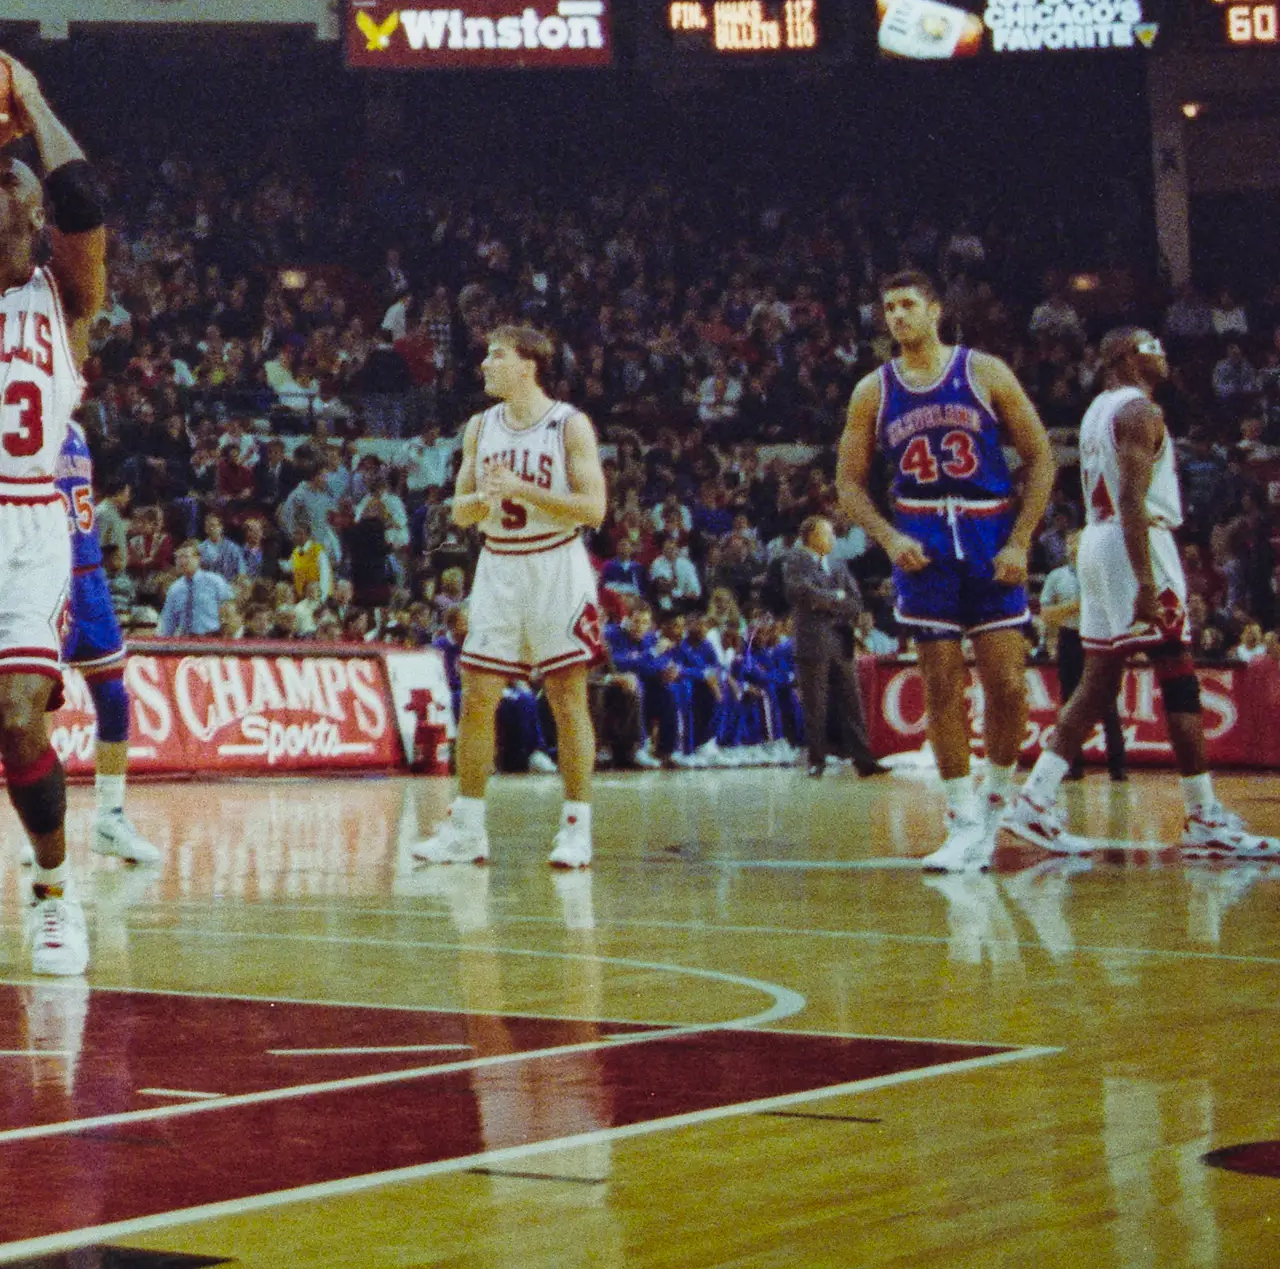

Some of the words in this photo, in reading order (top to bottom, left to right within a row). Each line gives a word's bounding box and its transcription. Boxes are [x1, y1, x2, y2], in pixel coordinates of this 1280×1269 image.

[399, 7, 605, 50] Winston
[714, 22, 780, 50] BULLETS
[983, 2, 1143, 30] CHICAGO'S
[1226, 5, 1277, 44] 60
[990, 24, 1137, 52] FAVORITE
[899, 429, 979, 484] 43
[174, 654, 386, 743] CHAMPS
[240, 713, 343, 764] Sports
